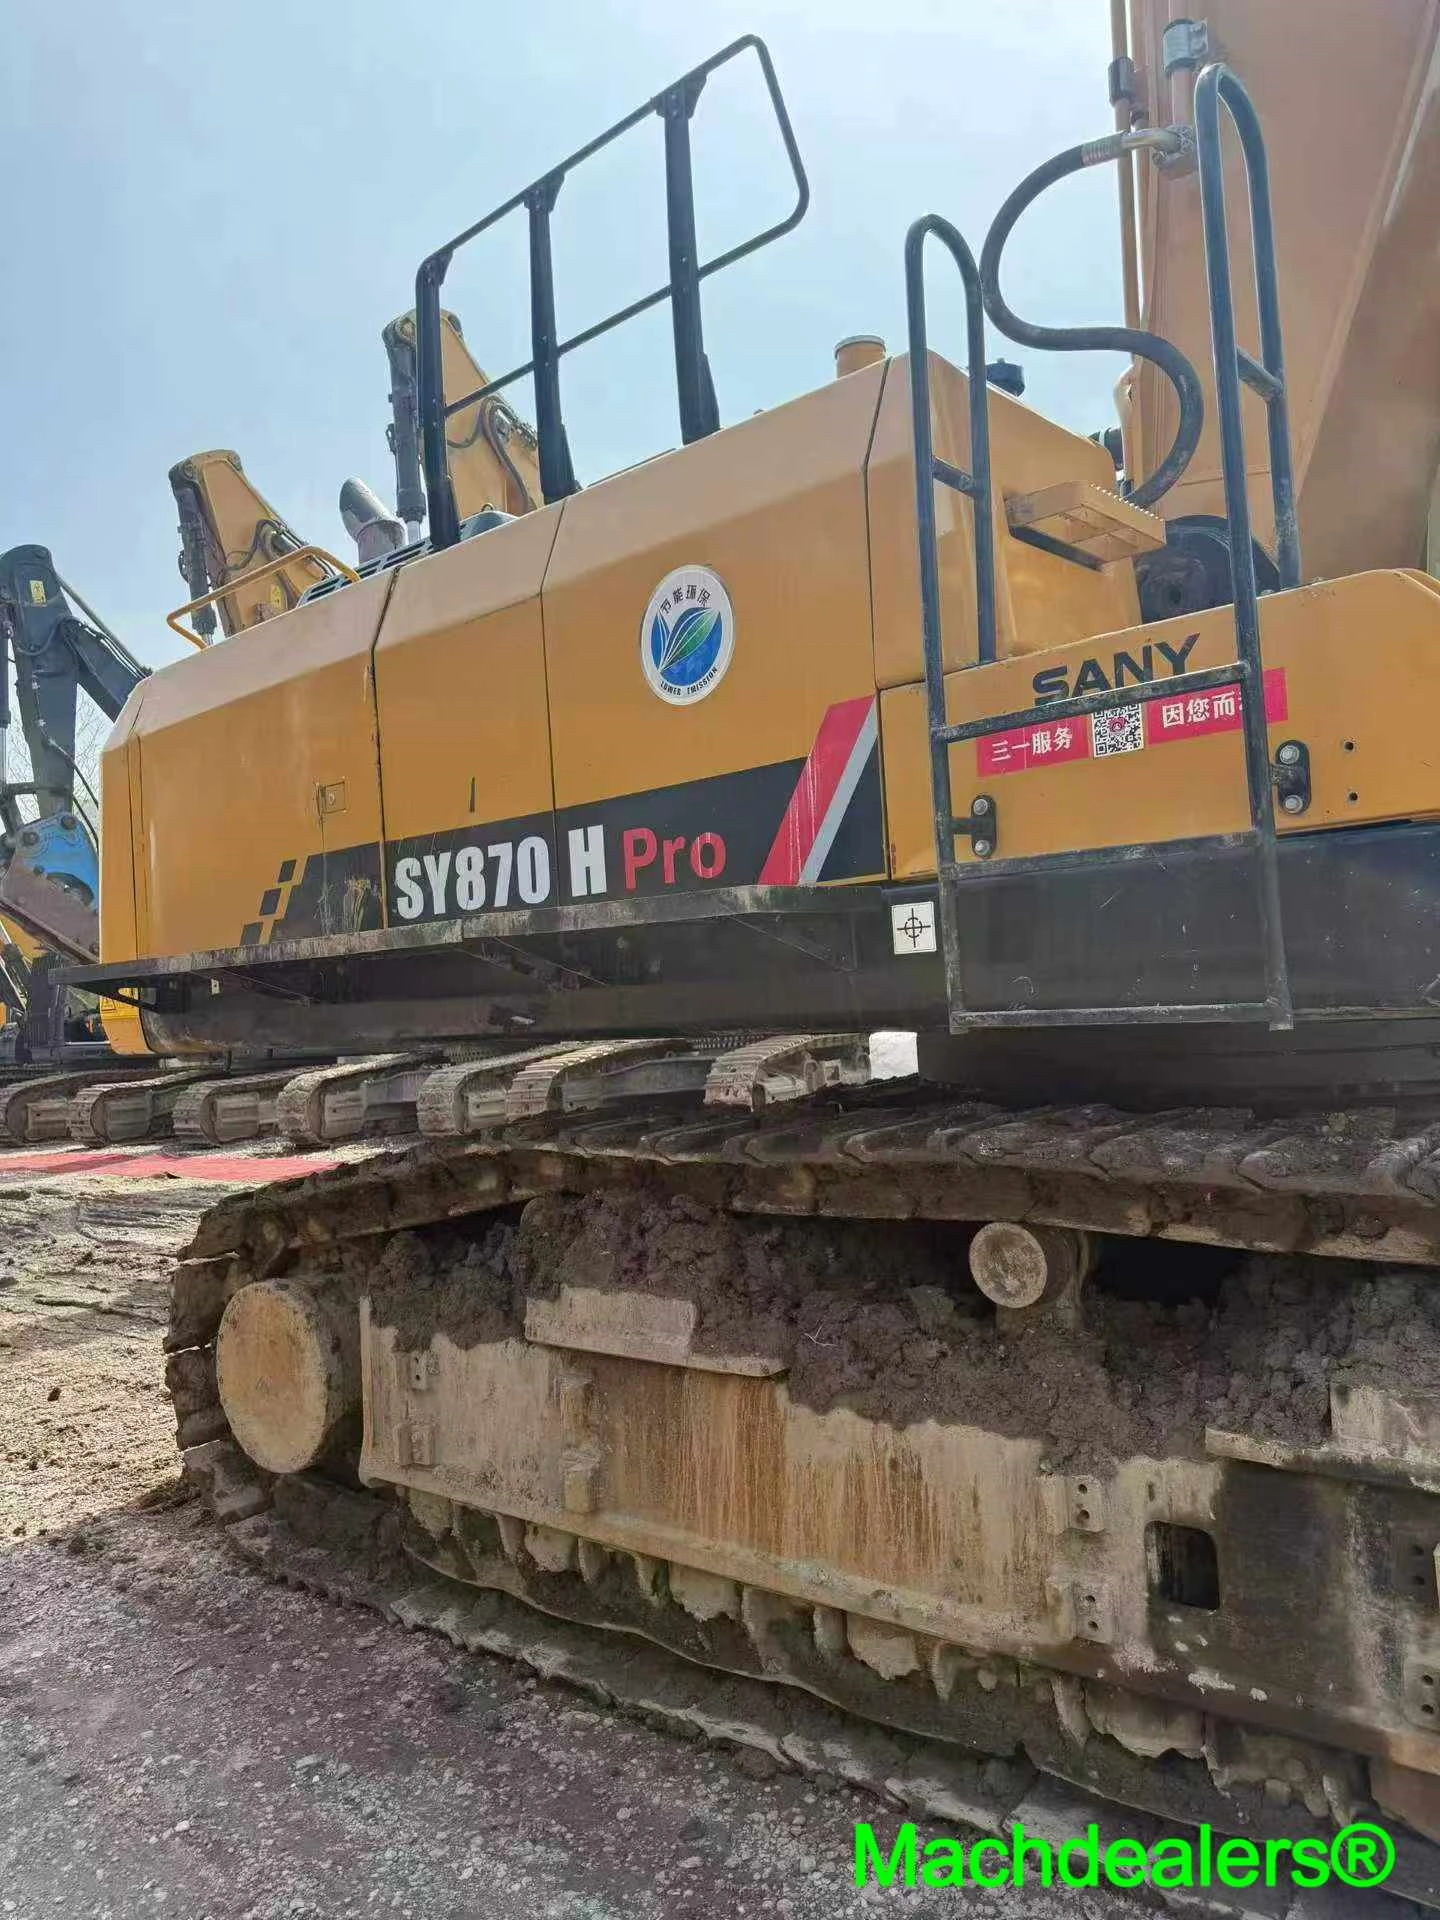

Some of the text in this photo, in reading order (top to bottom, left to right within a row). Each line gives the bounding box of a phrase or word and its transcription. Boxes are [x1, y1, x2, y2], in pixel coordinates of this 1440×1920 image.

[1032, 632, 1200, 706] SANY
[1162, 690, 1245, 729] 因您而
[991, 727, 1073, 762] 三一服务
[394, 824, 727, 920] SY870 H Pro
